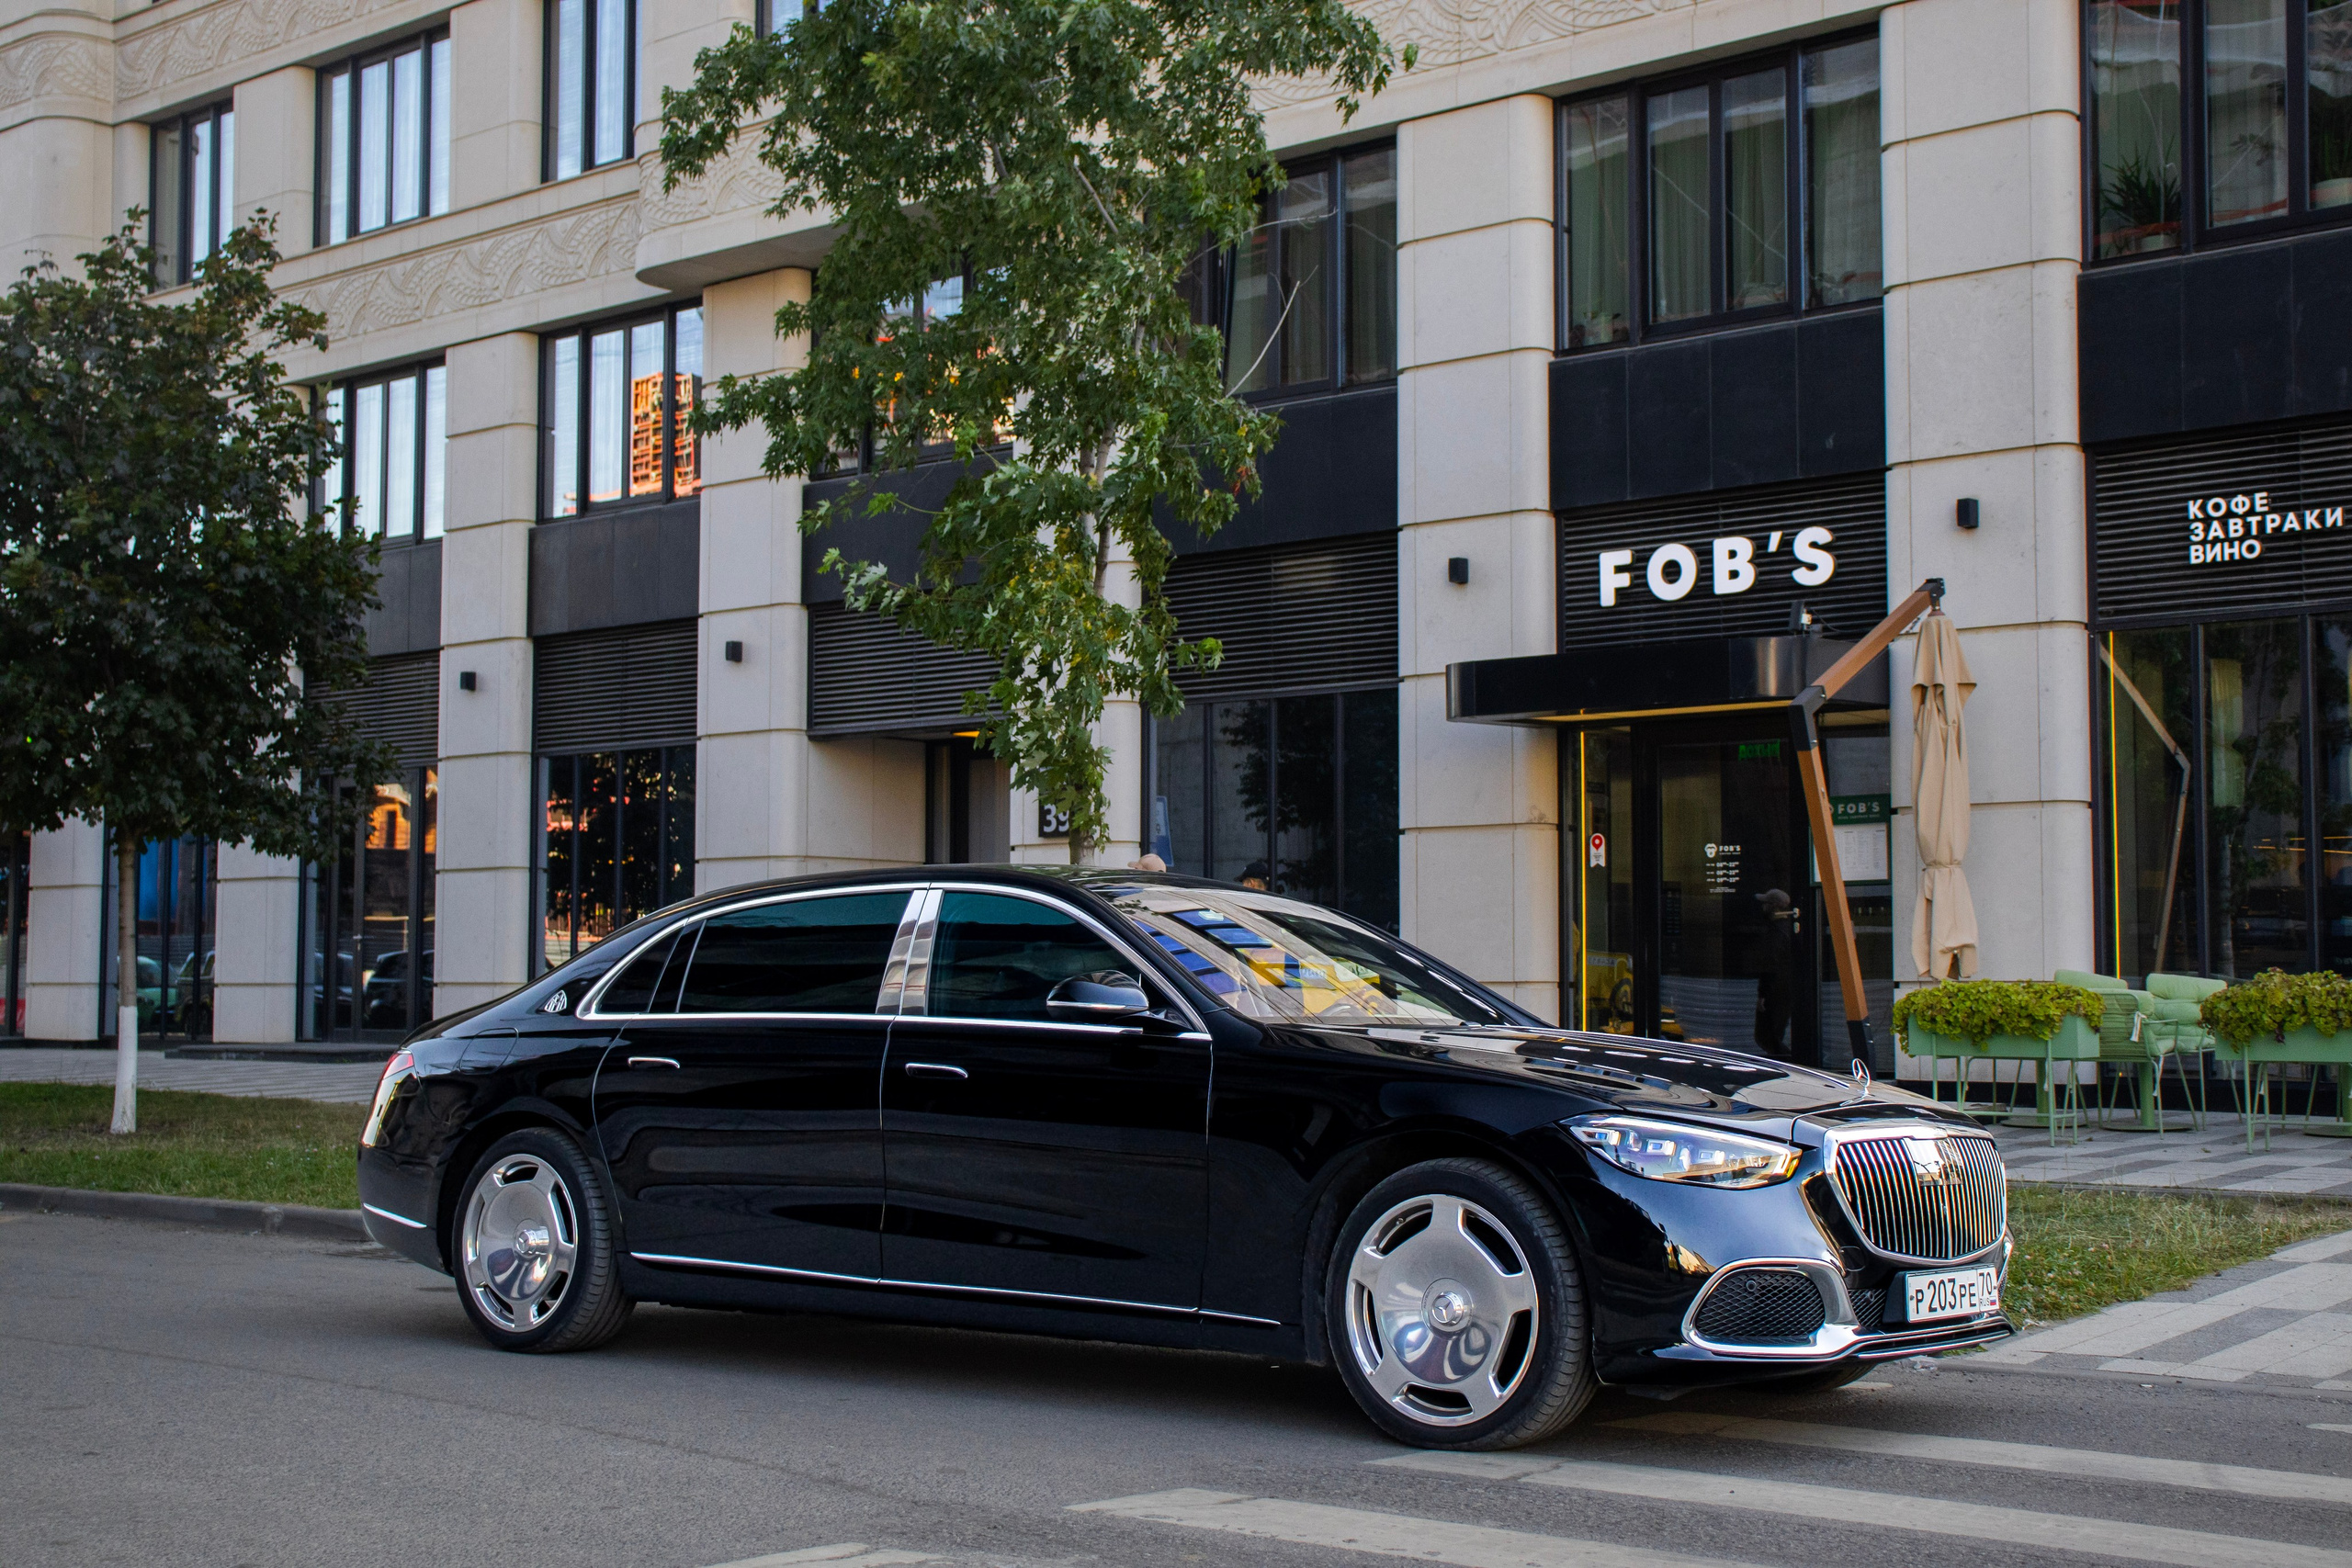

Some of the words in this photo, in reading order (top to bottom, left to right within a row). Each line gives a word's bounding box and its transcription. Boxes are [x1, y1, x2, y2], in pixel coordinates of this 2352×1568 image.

[2188, 491, 2269, 520] КОФЕ
[2189, 507, 2344, 542] ЗАВТРАКИ
[2189, 538, 2262, 565] ВИНО
[1600, 526, 1837, 607] FOB'S
[1838, 802, 1881, 814] FOB'S
[1978, 1271, 1993, 1297] 70
